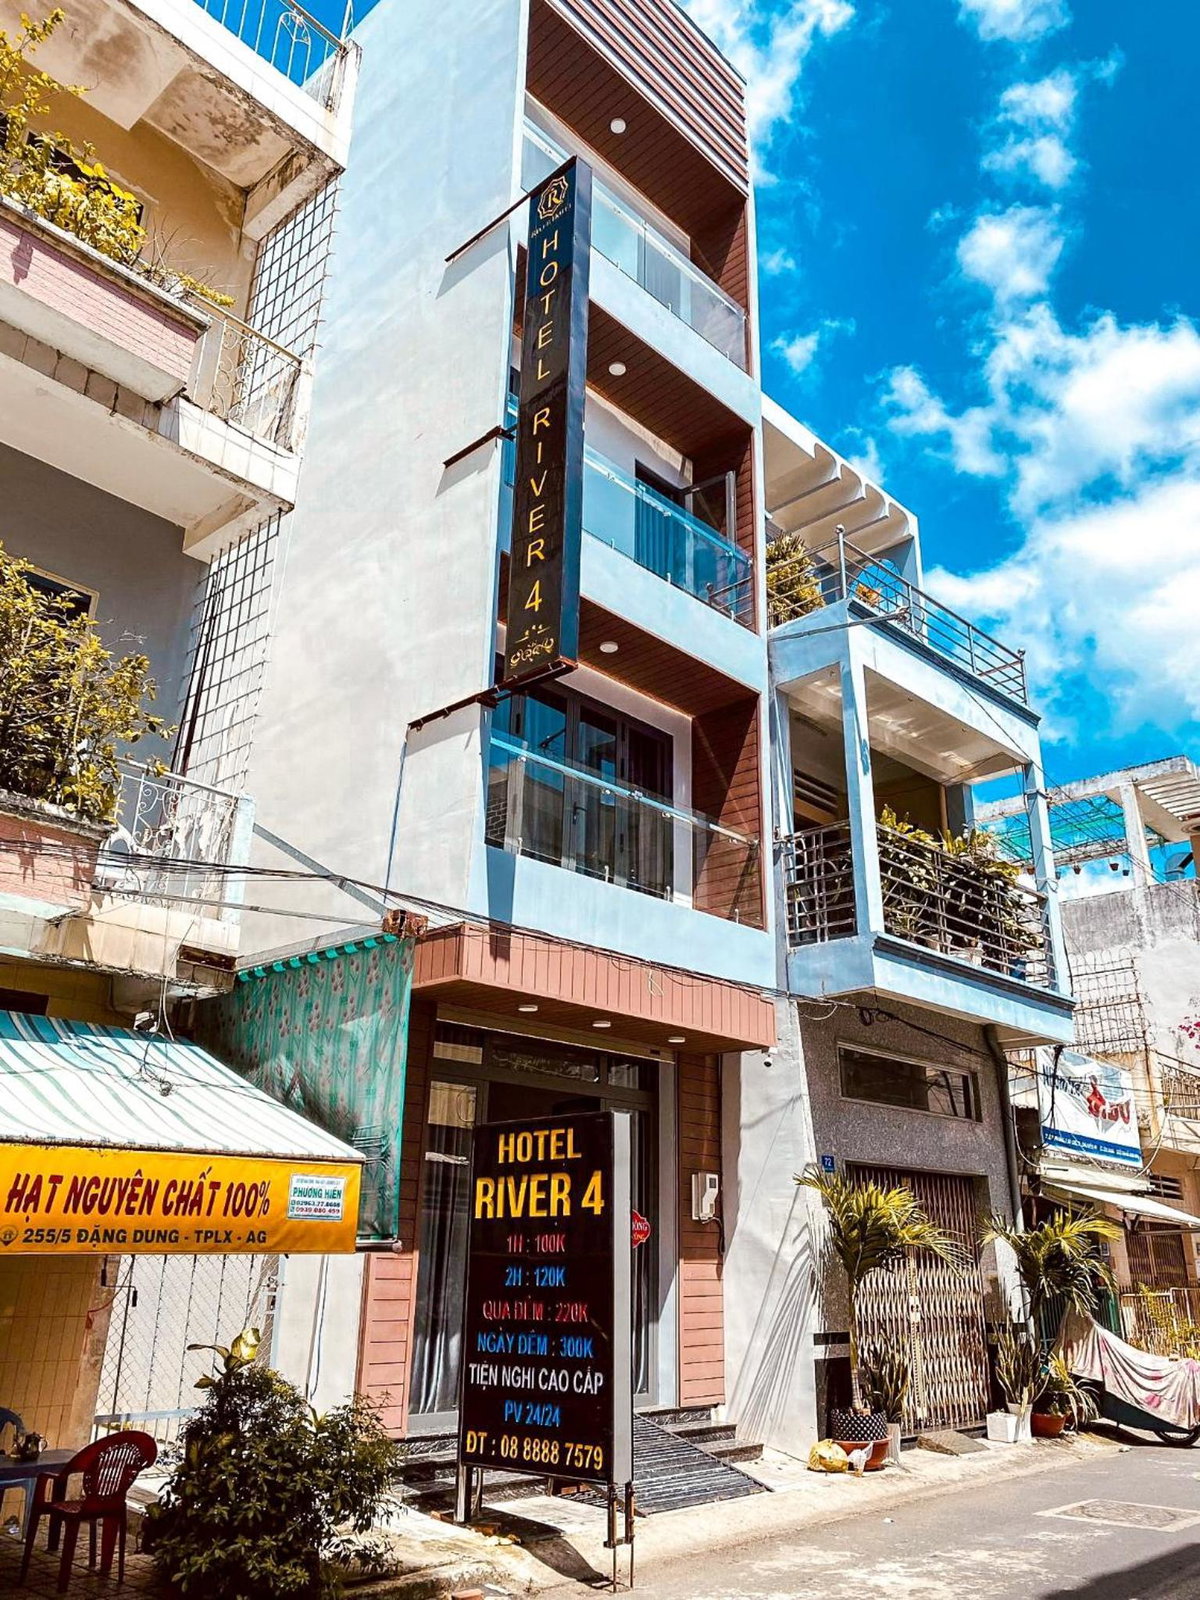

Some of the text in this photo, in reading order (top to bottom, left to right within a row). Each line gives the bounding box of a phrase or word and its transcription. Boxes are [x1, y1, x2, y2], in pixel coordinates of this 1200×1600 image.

[537, 229, 559, 381] HOTEL
[526, 407, 551, 567] RIVER
[524, 579, 543, 612] 4
[498, 1127, 582, 1164] HOTEL
[62, 1168, 160, 1216] NGUYÊN
[161, 1166, 221, 1217] CHẤT
[222, 1180, 270, 1218] 100%
[474, 1169, 605, 1219] RIVER 4
[22, 1227, 71, 1245] 255/5
[76, 1223, 127, 1248] ĐẶNG
[132, 1229, 179, 1244] DUNG
[194, 1230, 233, 1244] TPLX
[246, 1230, 267, 1244] AG
[534, 1234, 566, 1253] 100K
[505, 1265, 522, 1287] 2H
[533, 1265, 566, 1287] 120K
[482, 1300, 511, 1320] QUA
[555, 1302, 588, 1322] 220K
[517, 1329, 547, 1355] ĐÊM
[559, 1336, 594, 1358] 300K
[468, 1360, 498, 1390] TIỆN
[501, 1365, 535, 1389] NGHI
[538, 1367, 569, 1392] CAO
[504, 1399, 561, 1428] PV 24/24
[466, 1430, 488, 1455] ĐT
[500, 1434, 518, 1459] 08
[523, 1437, 559, 1465] 8888
[564, 1442, 603, 1471] 7579
